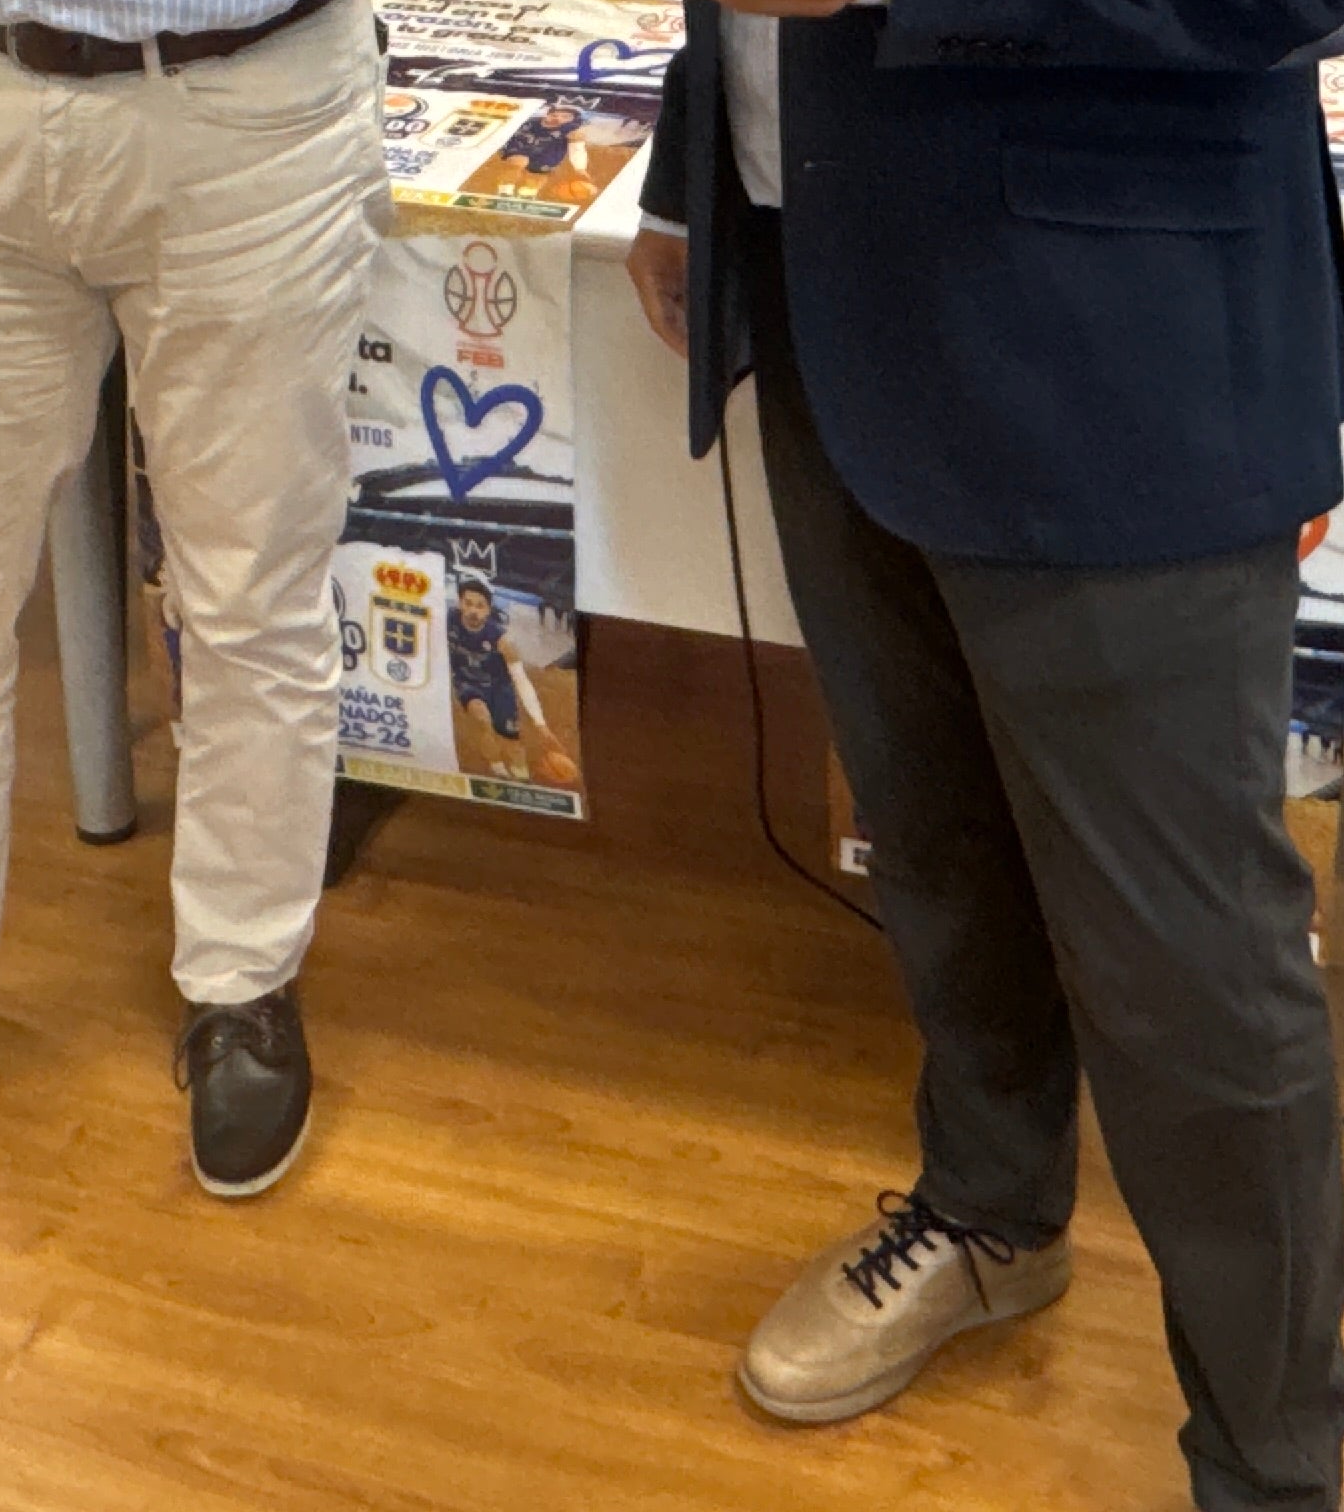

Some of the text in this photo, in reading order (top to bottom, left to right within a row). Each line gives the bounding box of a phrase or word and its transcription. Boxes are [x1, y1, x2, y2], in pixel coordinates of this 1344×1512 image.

[351, 424, 393, 448] NTOS
[339, 703, 409, 729] NADOS
[338, 721, 411, 748] 25-26
